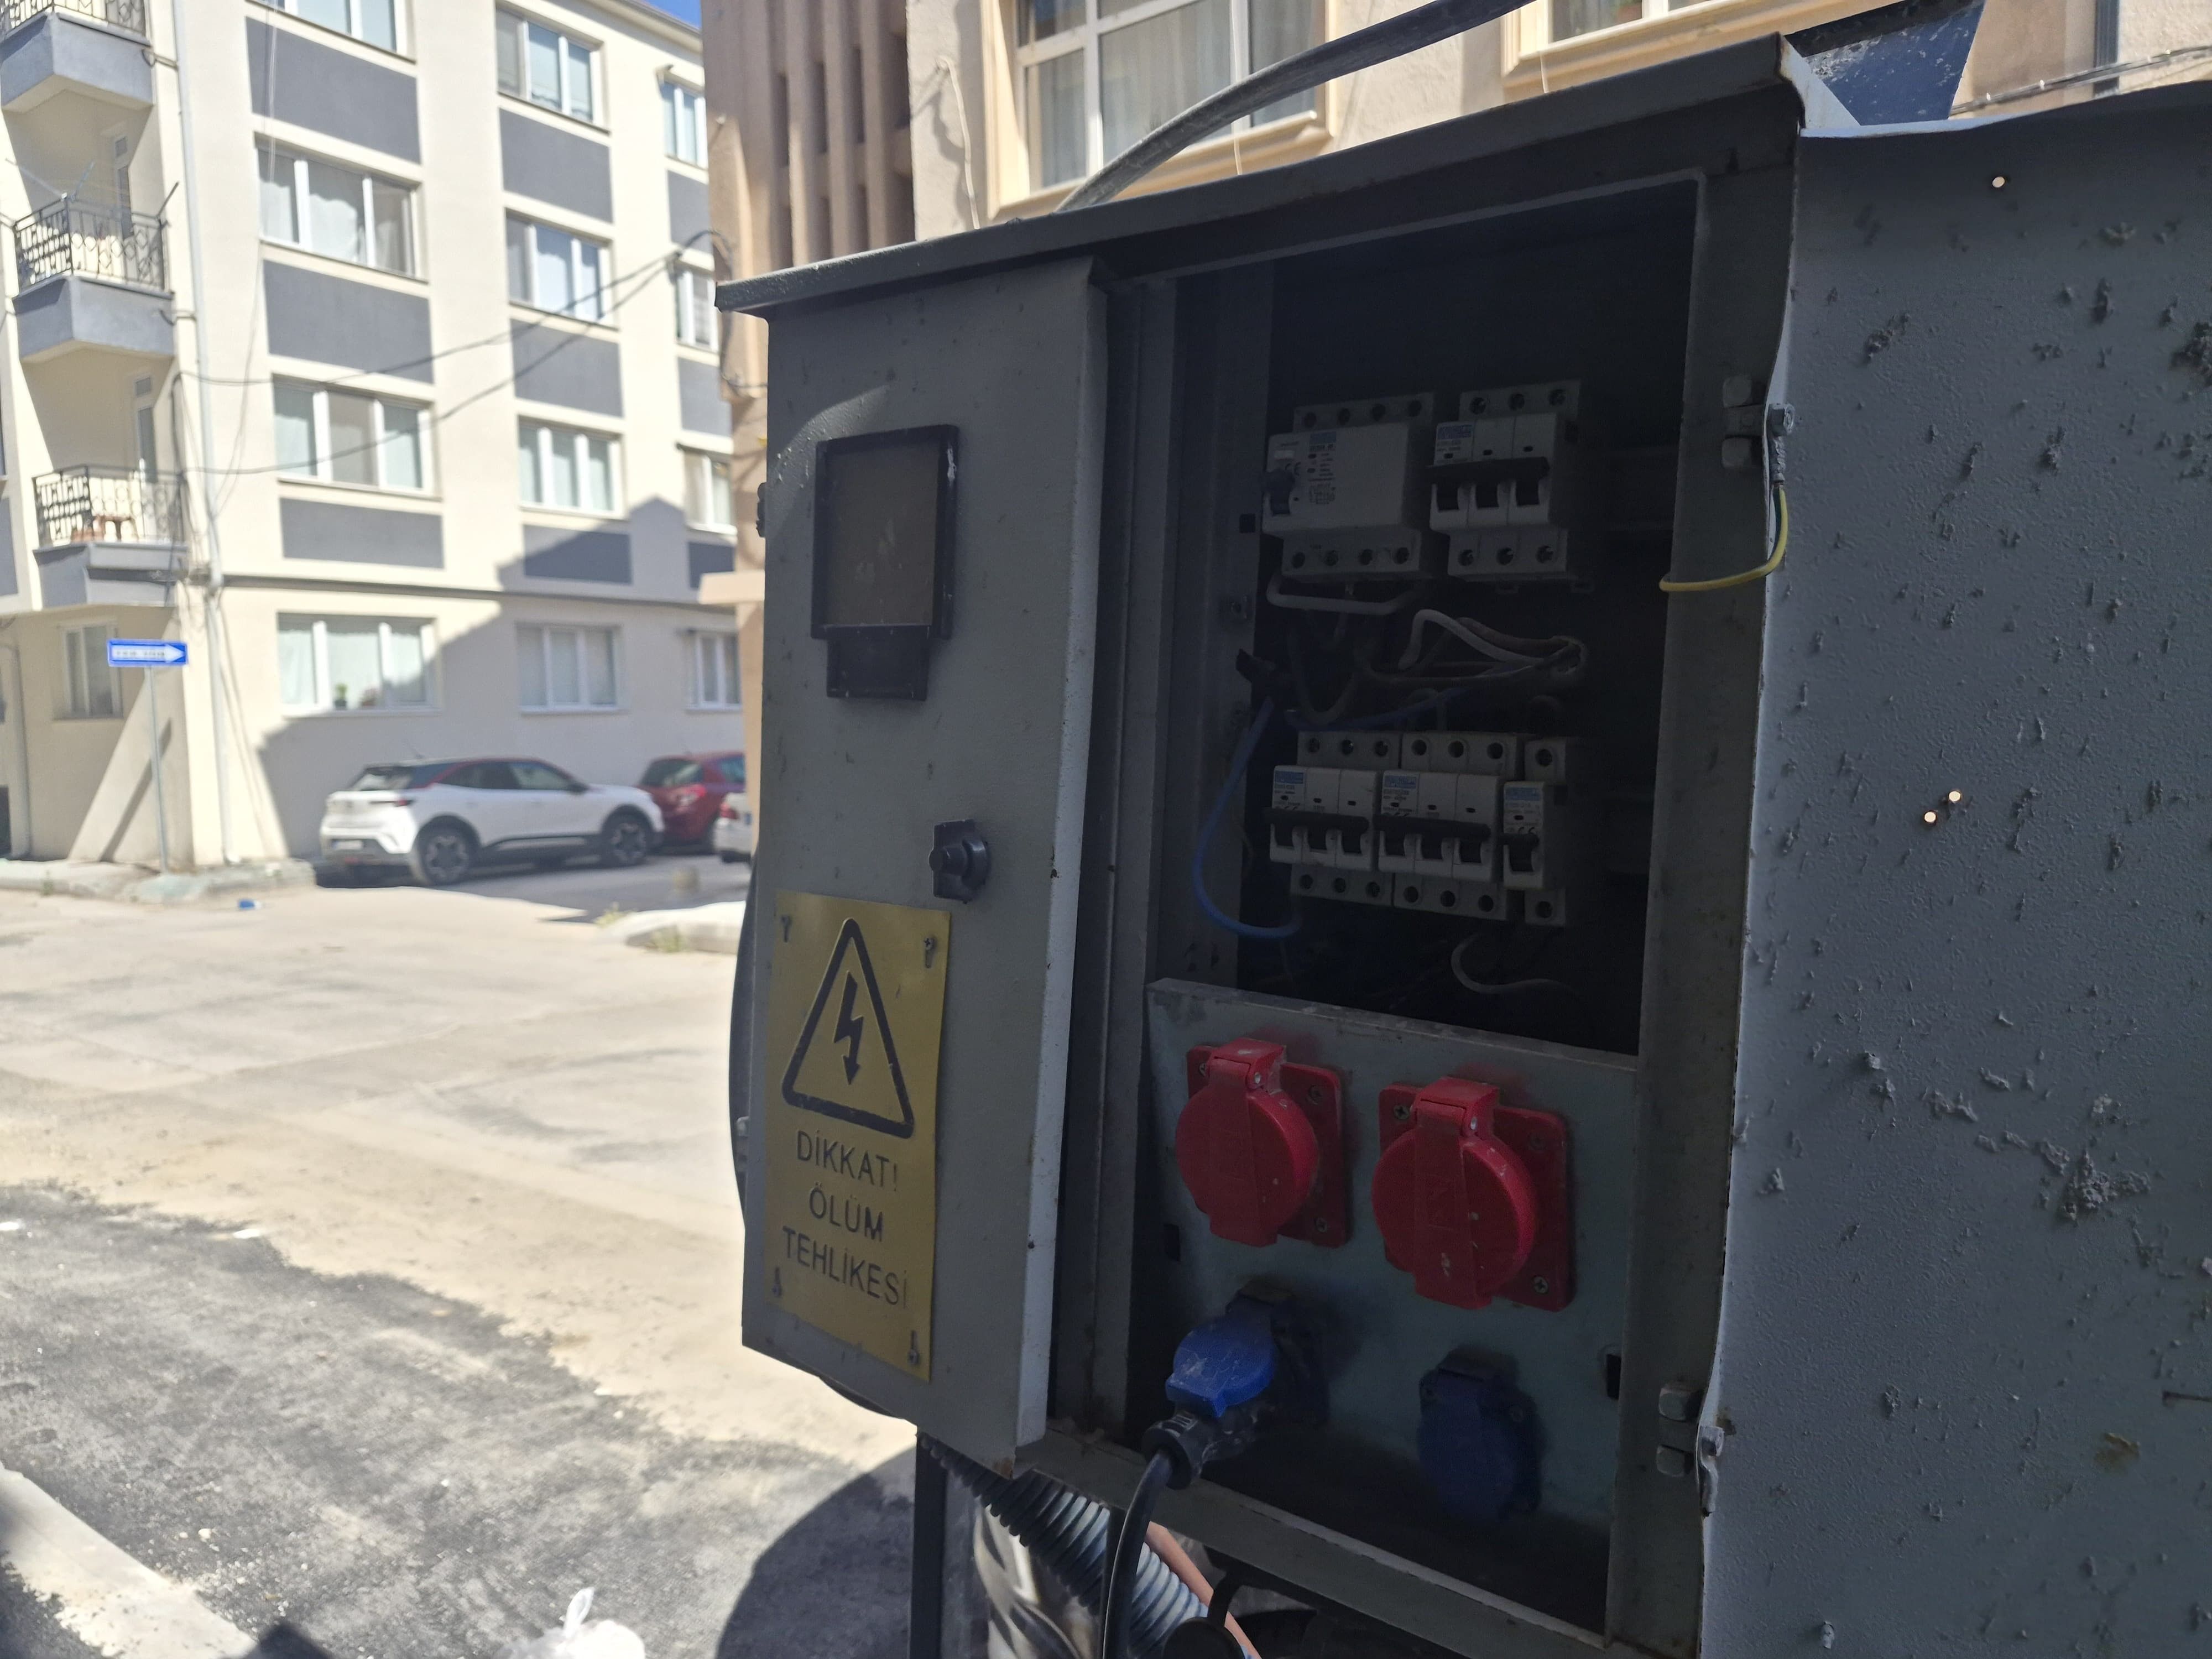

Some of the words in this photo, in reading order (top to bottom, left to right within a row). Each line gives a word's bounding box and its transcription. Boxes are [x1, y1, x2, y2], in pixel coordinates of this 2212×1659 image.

[796, 1128, 898, 1192] DİKKAT!
[808, 1181, 883, 1243] ÖLÜM
[782, 1225, 907, 1309] TEHLİKESİ
